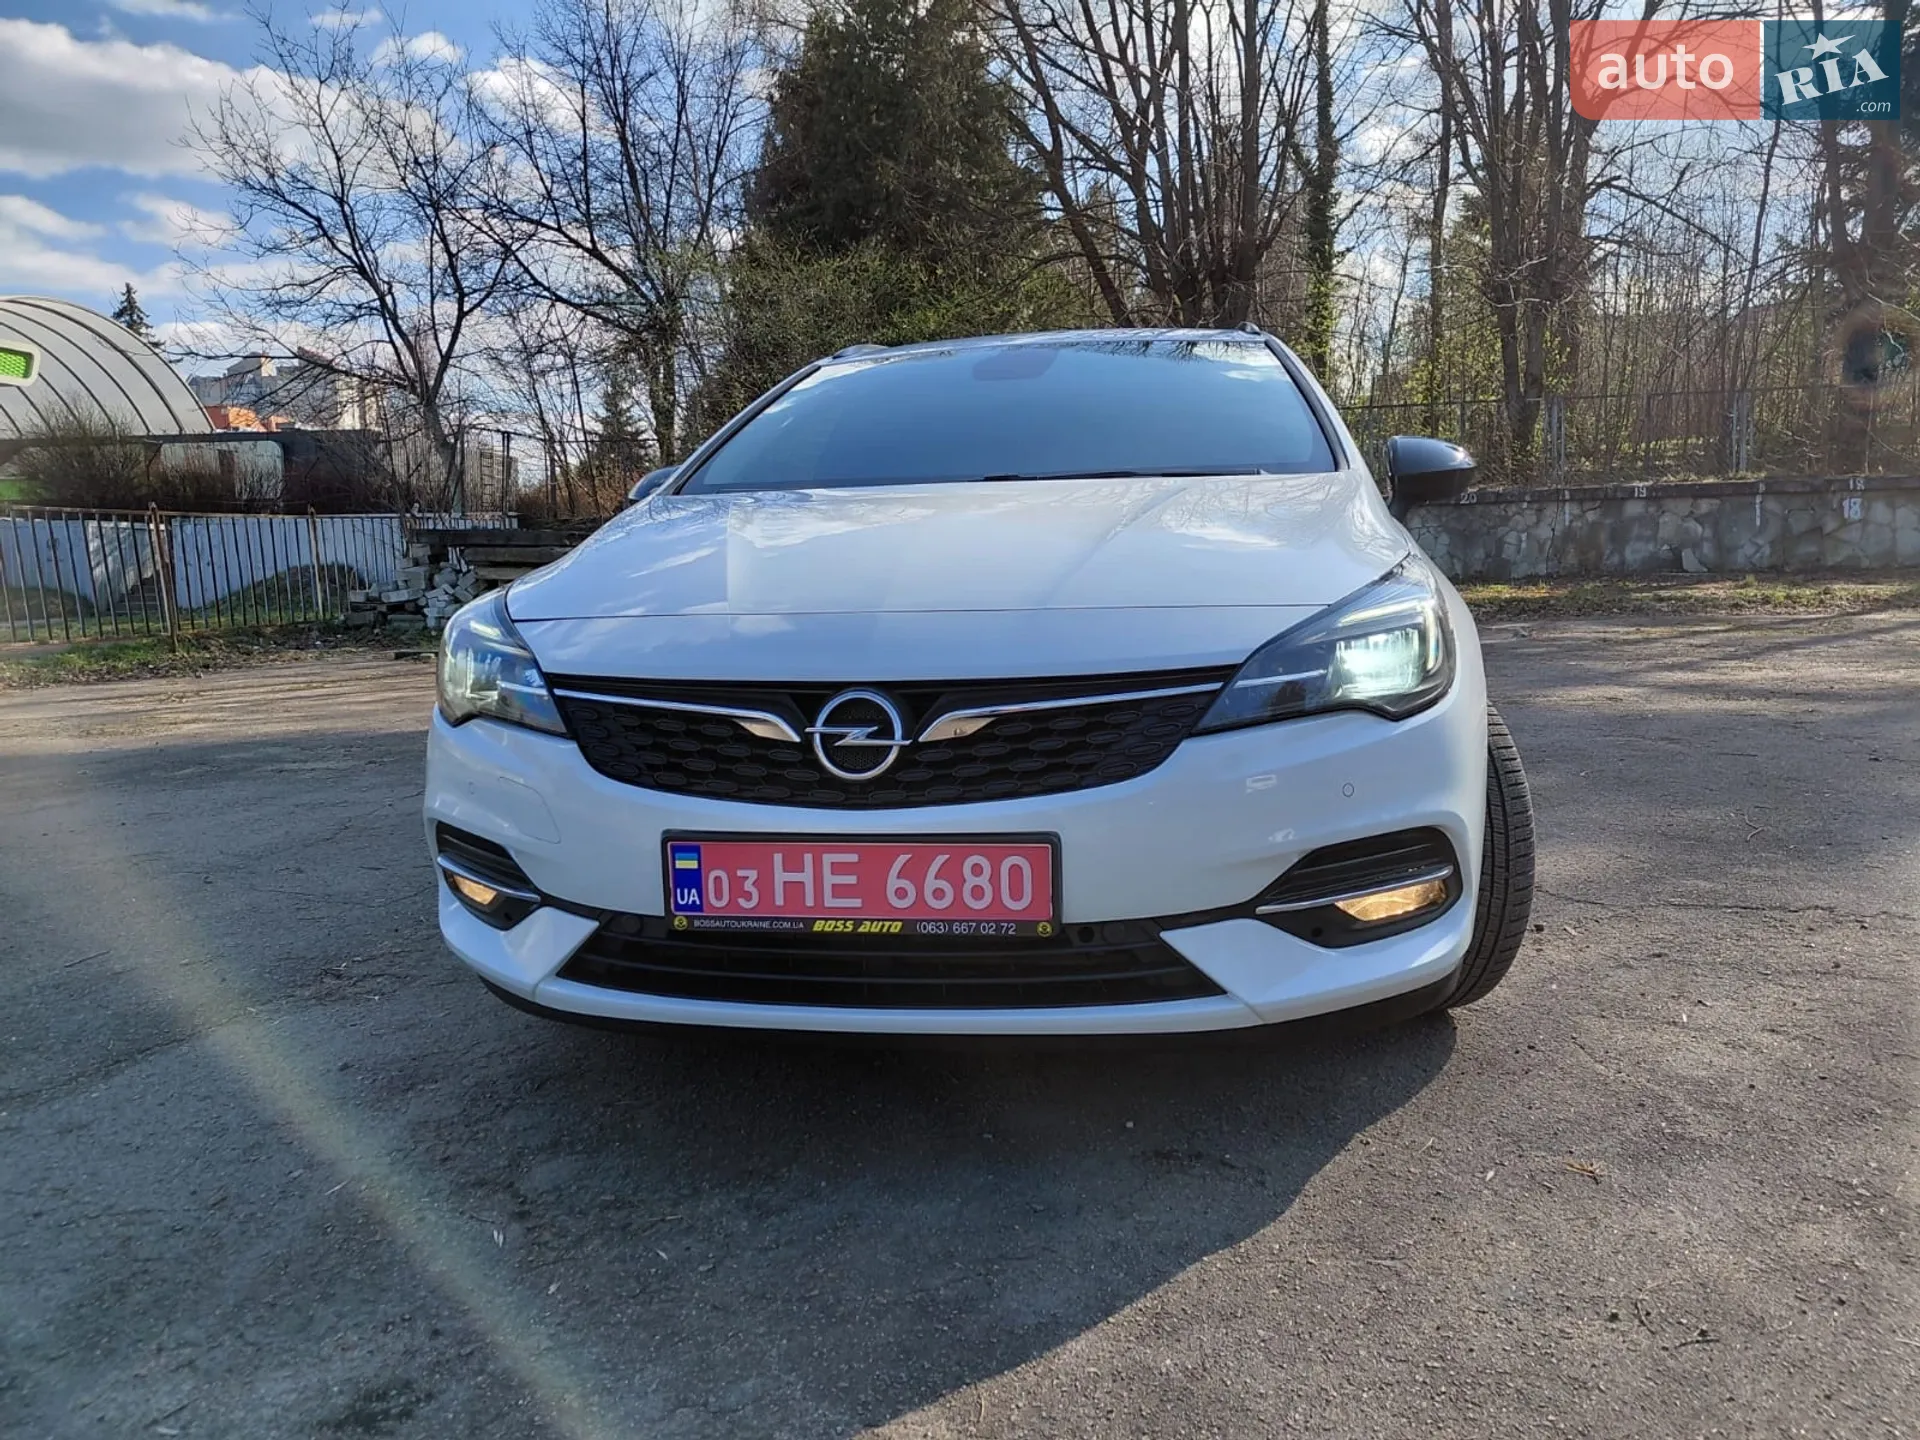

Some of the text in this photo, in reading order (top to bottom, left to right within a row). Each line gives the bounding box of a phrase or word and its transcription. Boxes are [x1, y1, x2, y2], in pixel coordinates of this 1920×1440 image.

[708, 853, 1033, 911] 03 HE 6680
[676, 887, 700, 905] UA
[693, 917, 1016, 935] BOSSAUTOUKRAINE.COM.UA BOSS AUTO (063) 667 02 72
